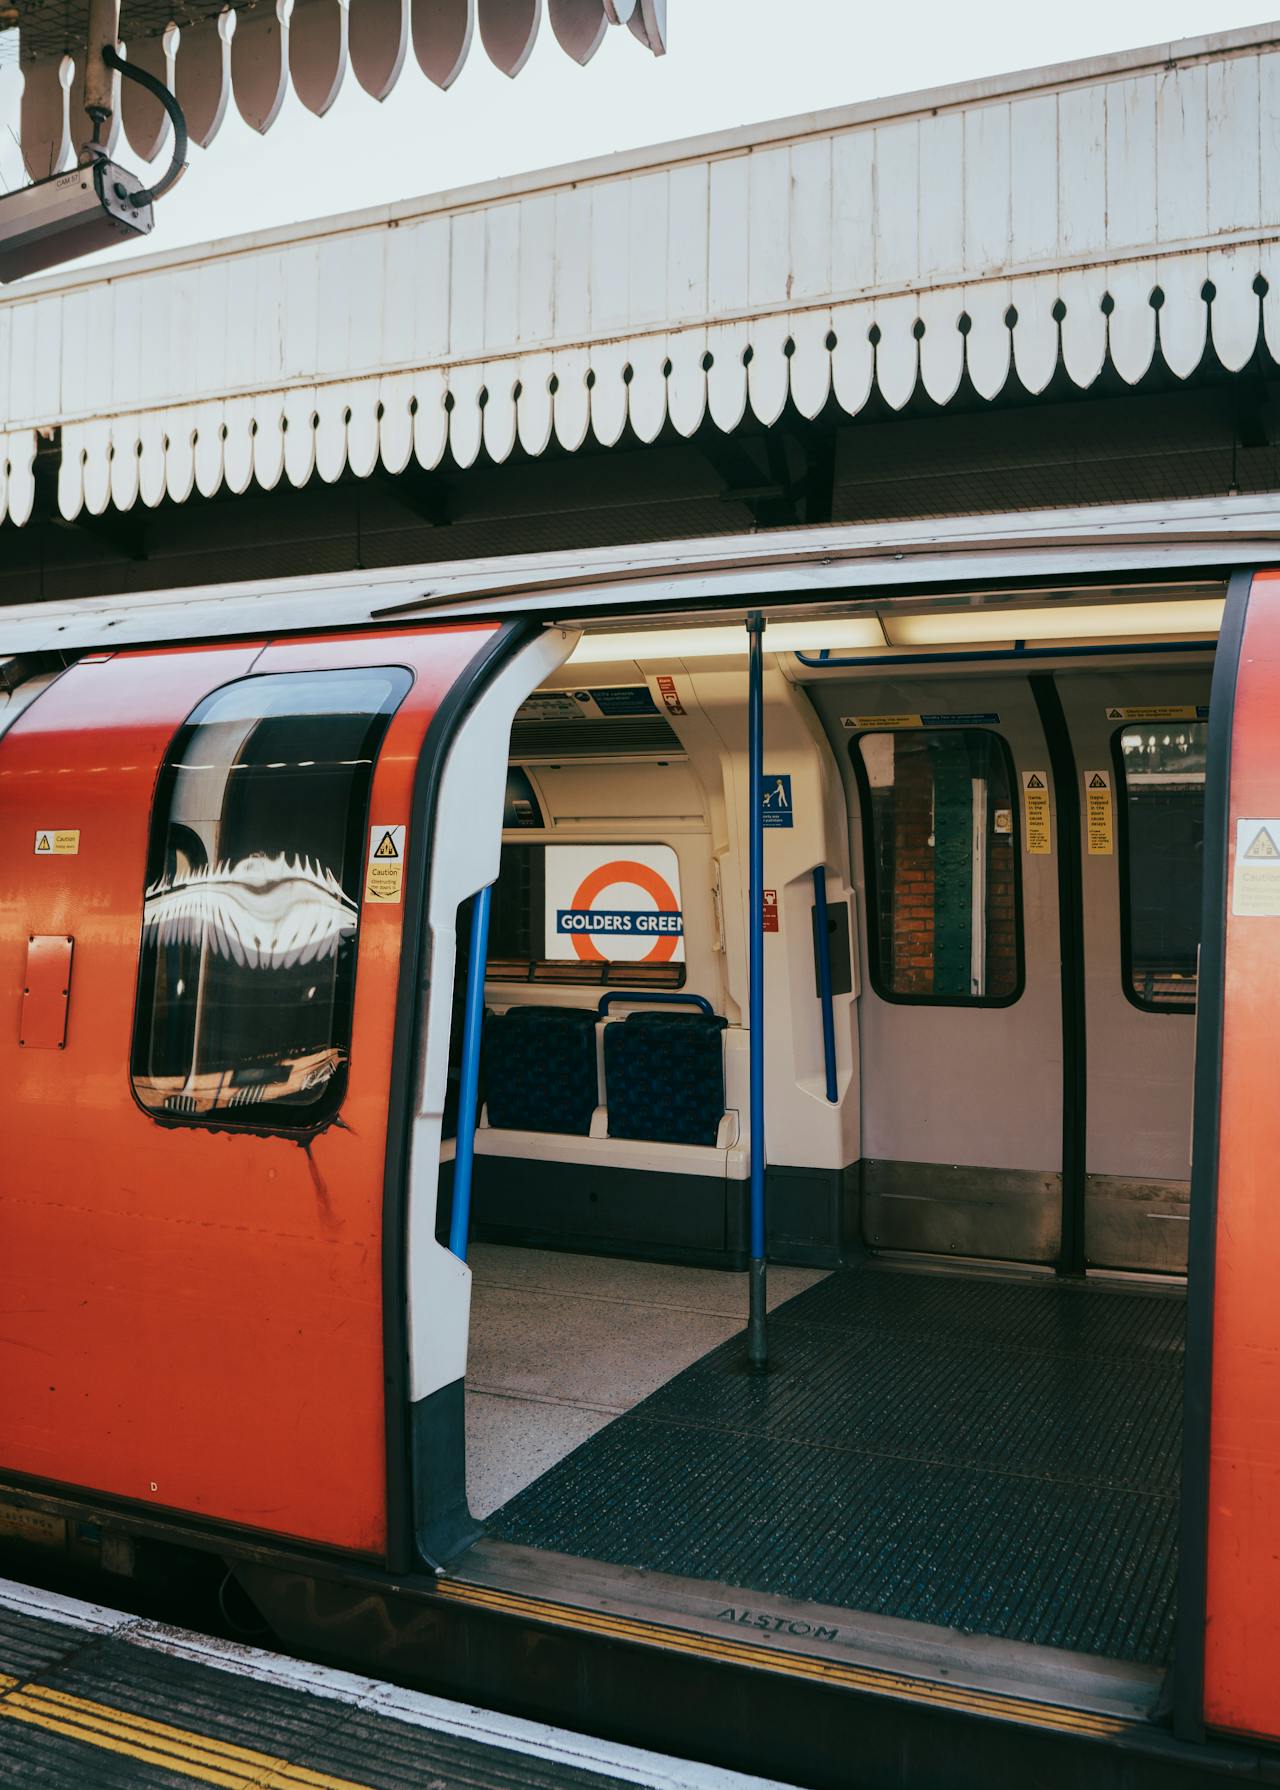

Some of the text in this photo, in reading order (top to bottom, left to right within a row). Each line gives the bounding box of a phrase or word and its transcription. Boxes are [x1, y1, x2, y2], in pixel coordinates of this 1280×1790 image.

[56, 174, 79, 187] CAM 57
[371, 868, 398, 876] Caution
[560, 914, 632, 931] GOLDERS
[150, 1481, 158, 1492] D
[717, 1607, 840, 1641] ALSTOM
